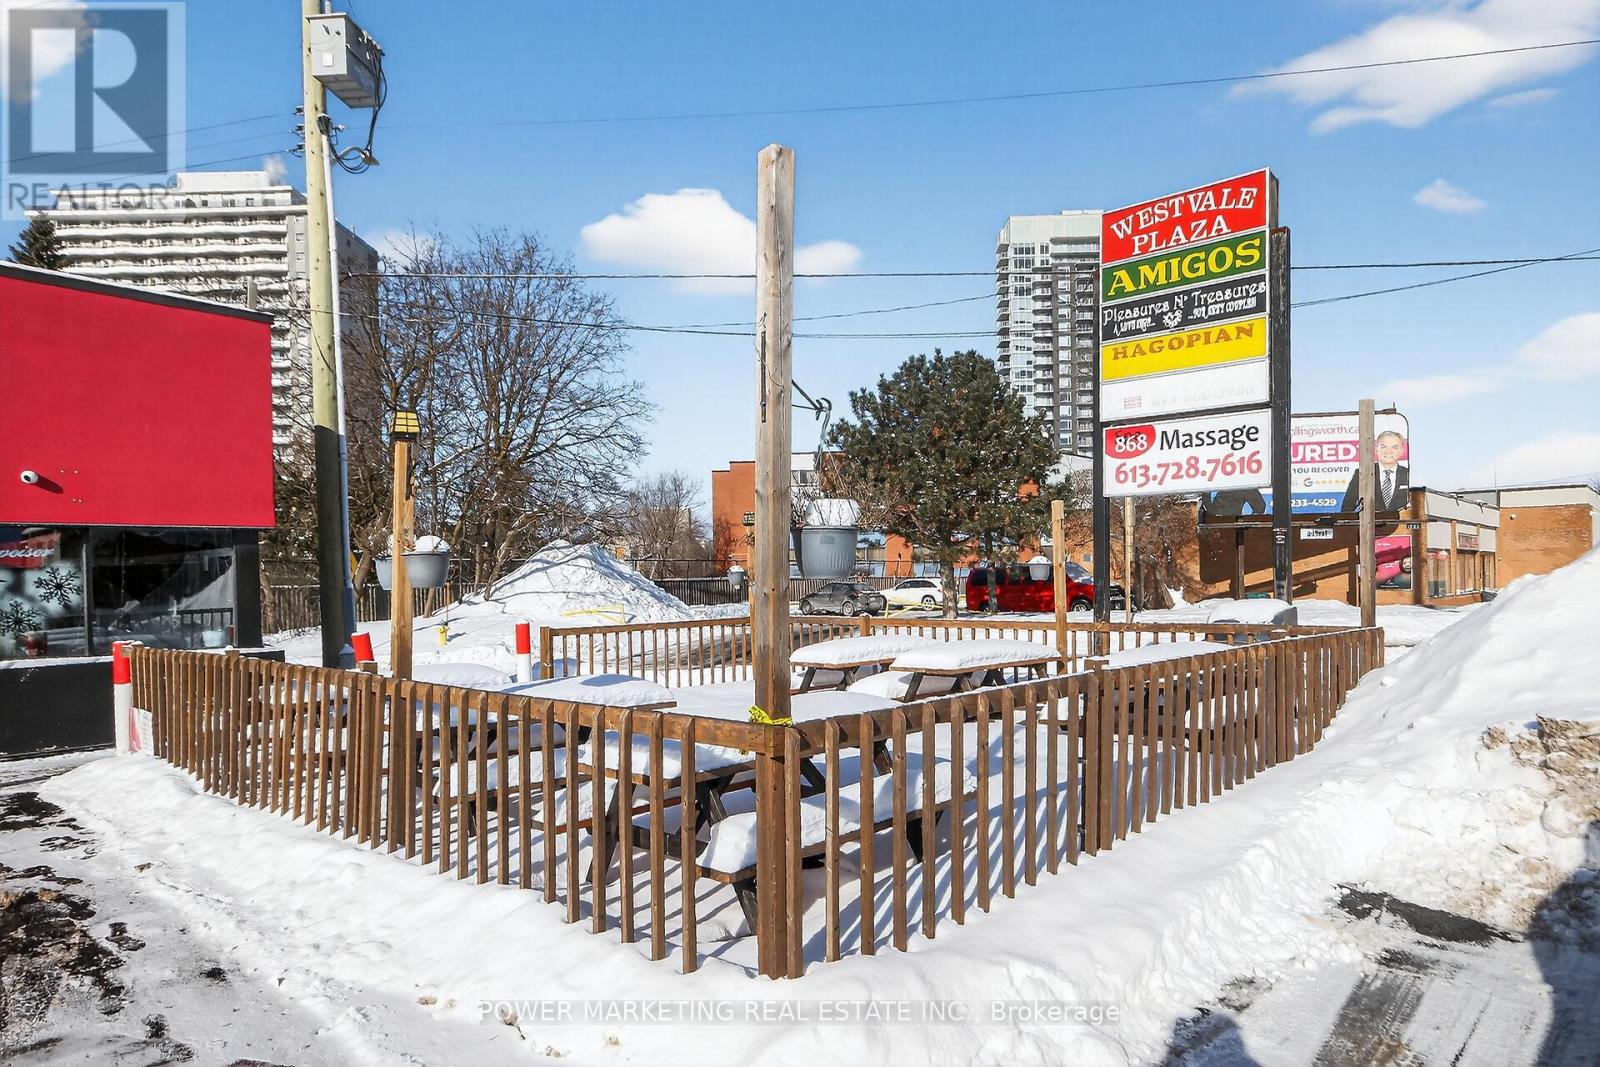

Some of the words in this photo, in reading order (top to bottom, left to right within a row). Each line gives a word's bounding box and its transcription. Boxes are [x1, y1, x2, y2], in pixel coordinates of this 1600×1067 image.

[1110, 187, 1257, 240] WESTVALE
[1132, 214, 1232, 256] PLAZA
[1108, 238, 1261, 296] AMIGOS
[1103, 301, 1170, 326] Pleasures
[1191, 281, 1266, 306] Treasures
[1112, 322, 1255, 360] HAGOPIAN
[1115, 433, 1148, 453] 868
[1160, 424, 1259, 450] Massage
[1291, 443, 1359, 462] URED
[1115, 450, 1263, 488] 613.728.7616
